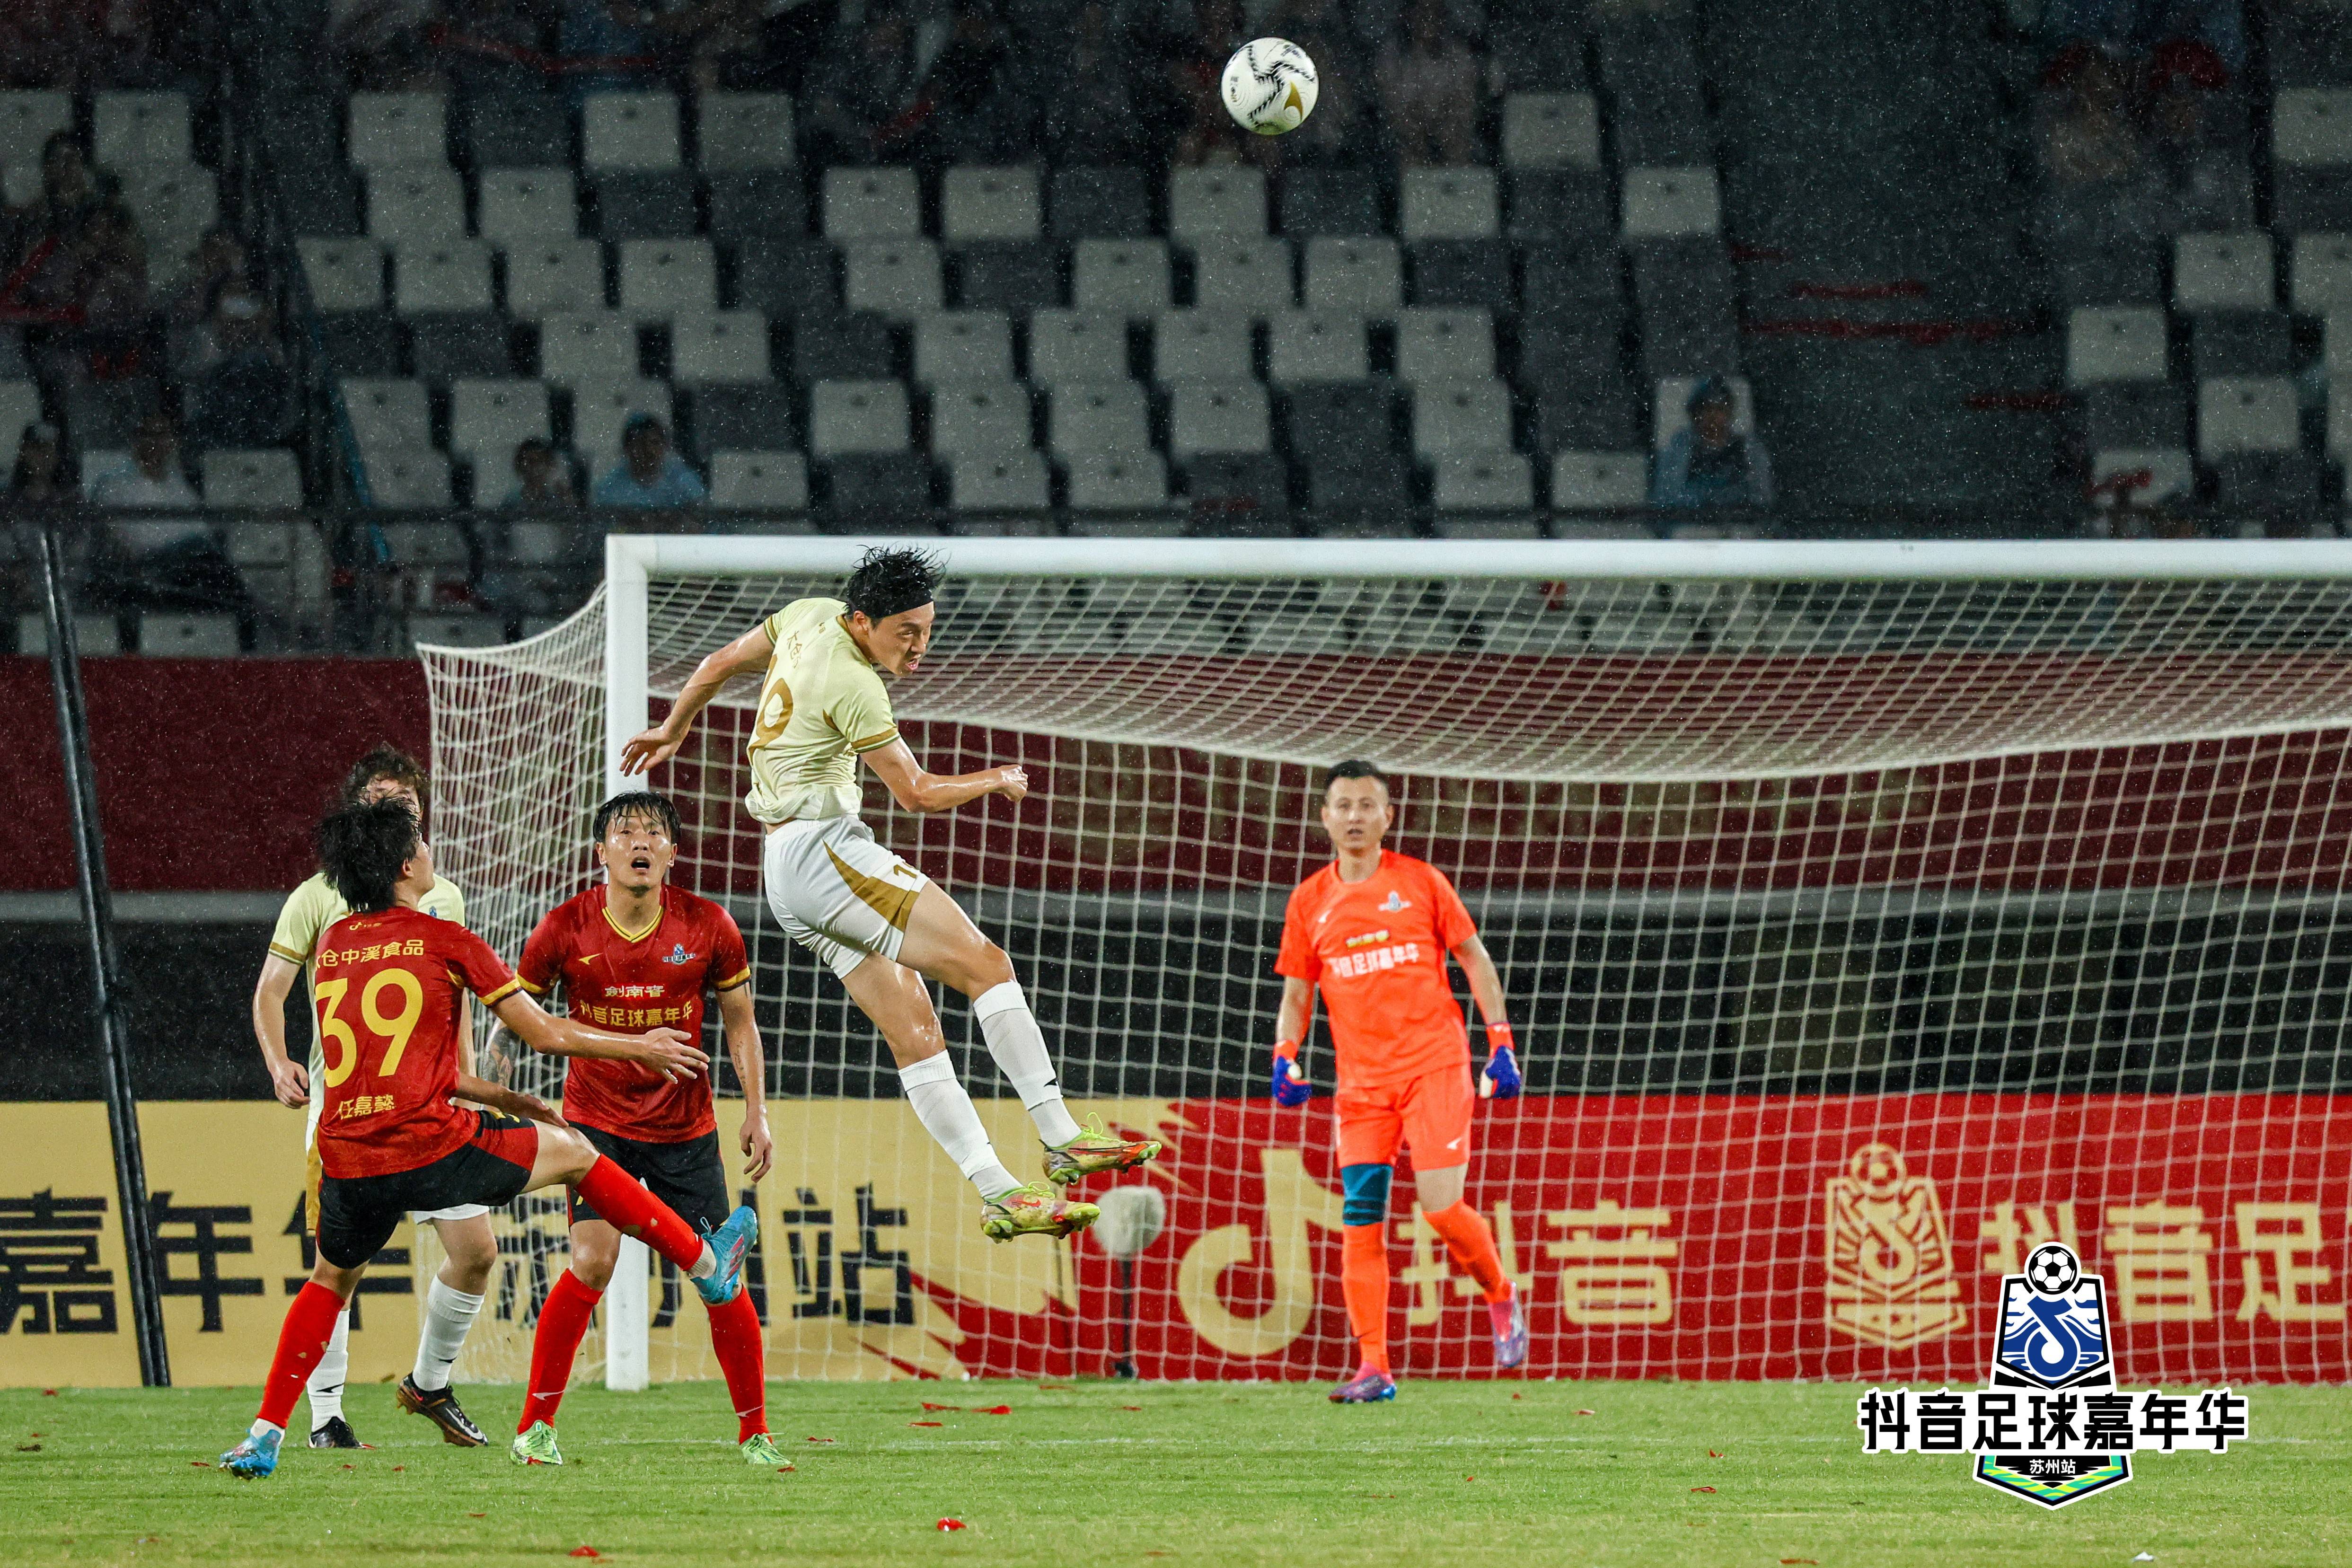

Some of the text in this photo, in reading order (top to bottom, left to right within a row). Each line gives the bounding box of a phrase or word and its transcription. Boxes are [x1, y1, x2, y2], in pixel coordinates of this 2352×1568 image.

[315, 968, 423, 1088] 39
[1397, 1198, 1679, 1325] 抖音
[1979, 1198, 2352, 1323] 抖音足
